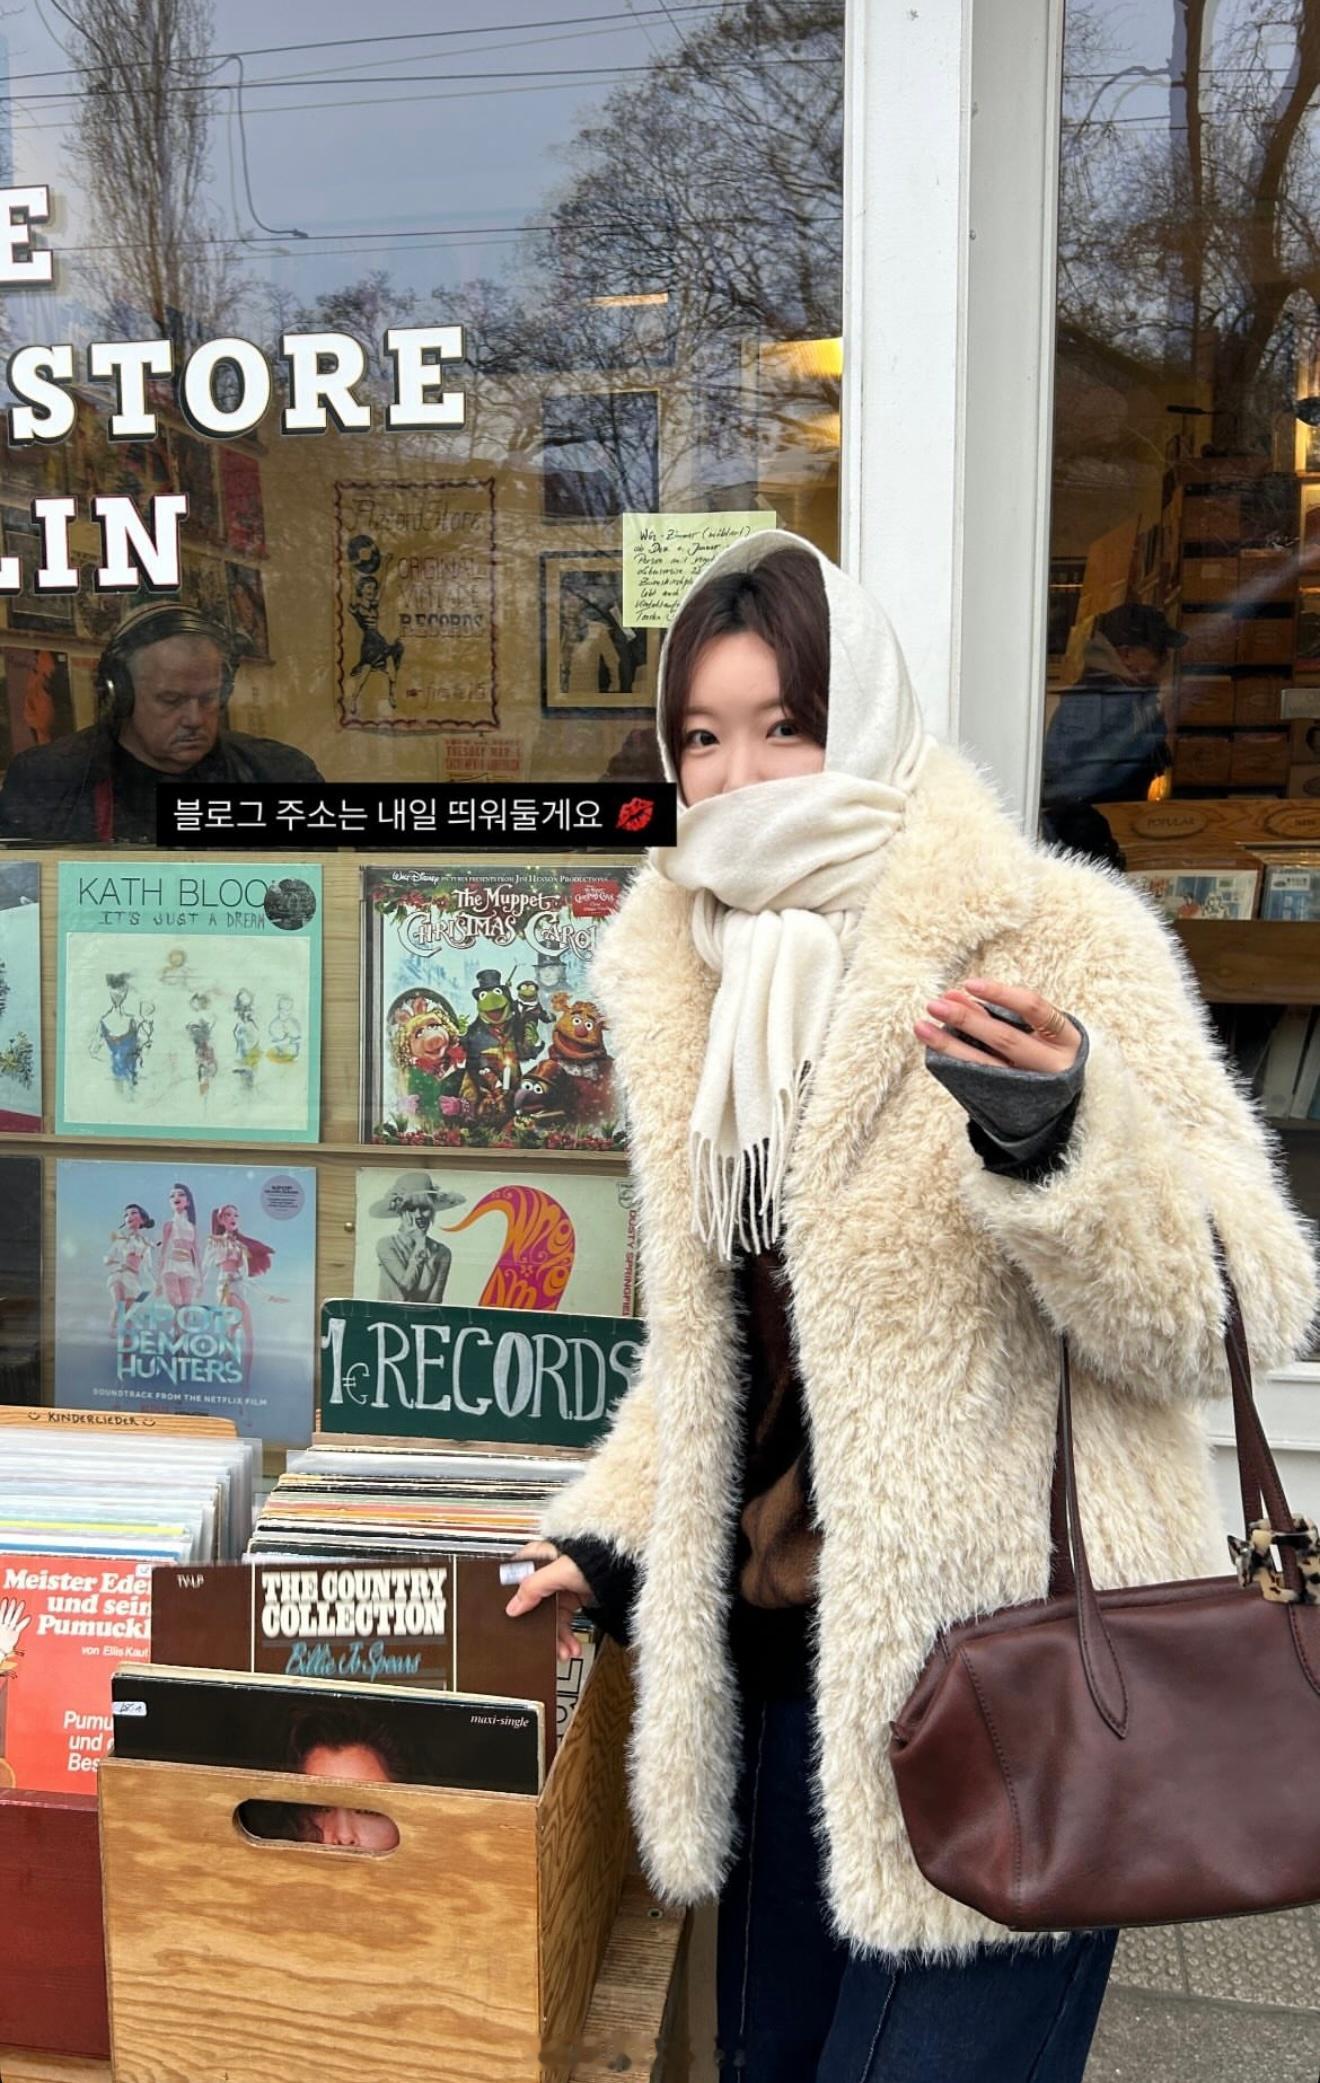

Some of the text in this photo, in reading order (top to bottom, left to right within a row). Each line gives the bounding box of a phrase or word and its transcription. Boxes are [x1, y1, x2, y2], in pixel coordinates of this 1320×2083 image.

[8, 325, 466, 447] STORE
[79, 877, 270, 908] KATH BLOO
[451, 887, 482, 908] The
[483, 883, 563, 917] Muppet
[99, 911, 141, 926] IT'S
[153, 911, 199, 926] JUST
[208, 912, 218, 927] A
[397, 911, 521, 958] CHRISTMAS
[116, 1329, 243, 1363] DEMON
[116, 1355, 243, 1385] HUNTERS
[367, 1321, 643, 1421] RECORDS
[92, 1387, 153, 1399] SOUNDTRACK
[155, 1390, 181, 1401] FROM
[184, 1393, 202, 1403] THE
[204, 1394, 243, 1405] NETFLIX
[47, 1411, 139, 1427] KINDERLIEDER
[3, 1569, 98, 1592] Meister
[262, 1567, 447, 1602] THE COUNTRY
[47, 1593, 99, 1614] und
[261, 1599, 447, 1638] COLLECTION
[82, 1646, 100, 1656] von
[471, 1714, 530, 1728] maxi-single
[69, 1732, 104, 1751] und
